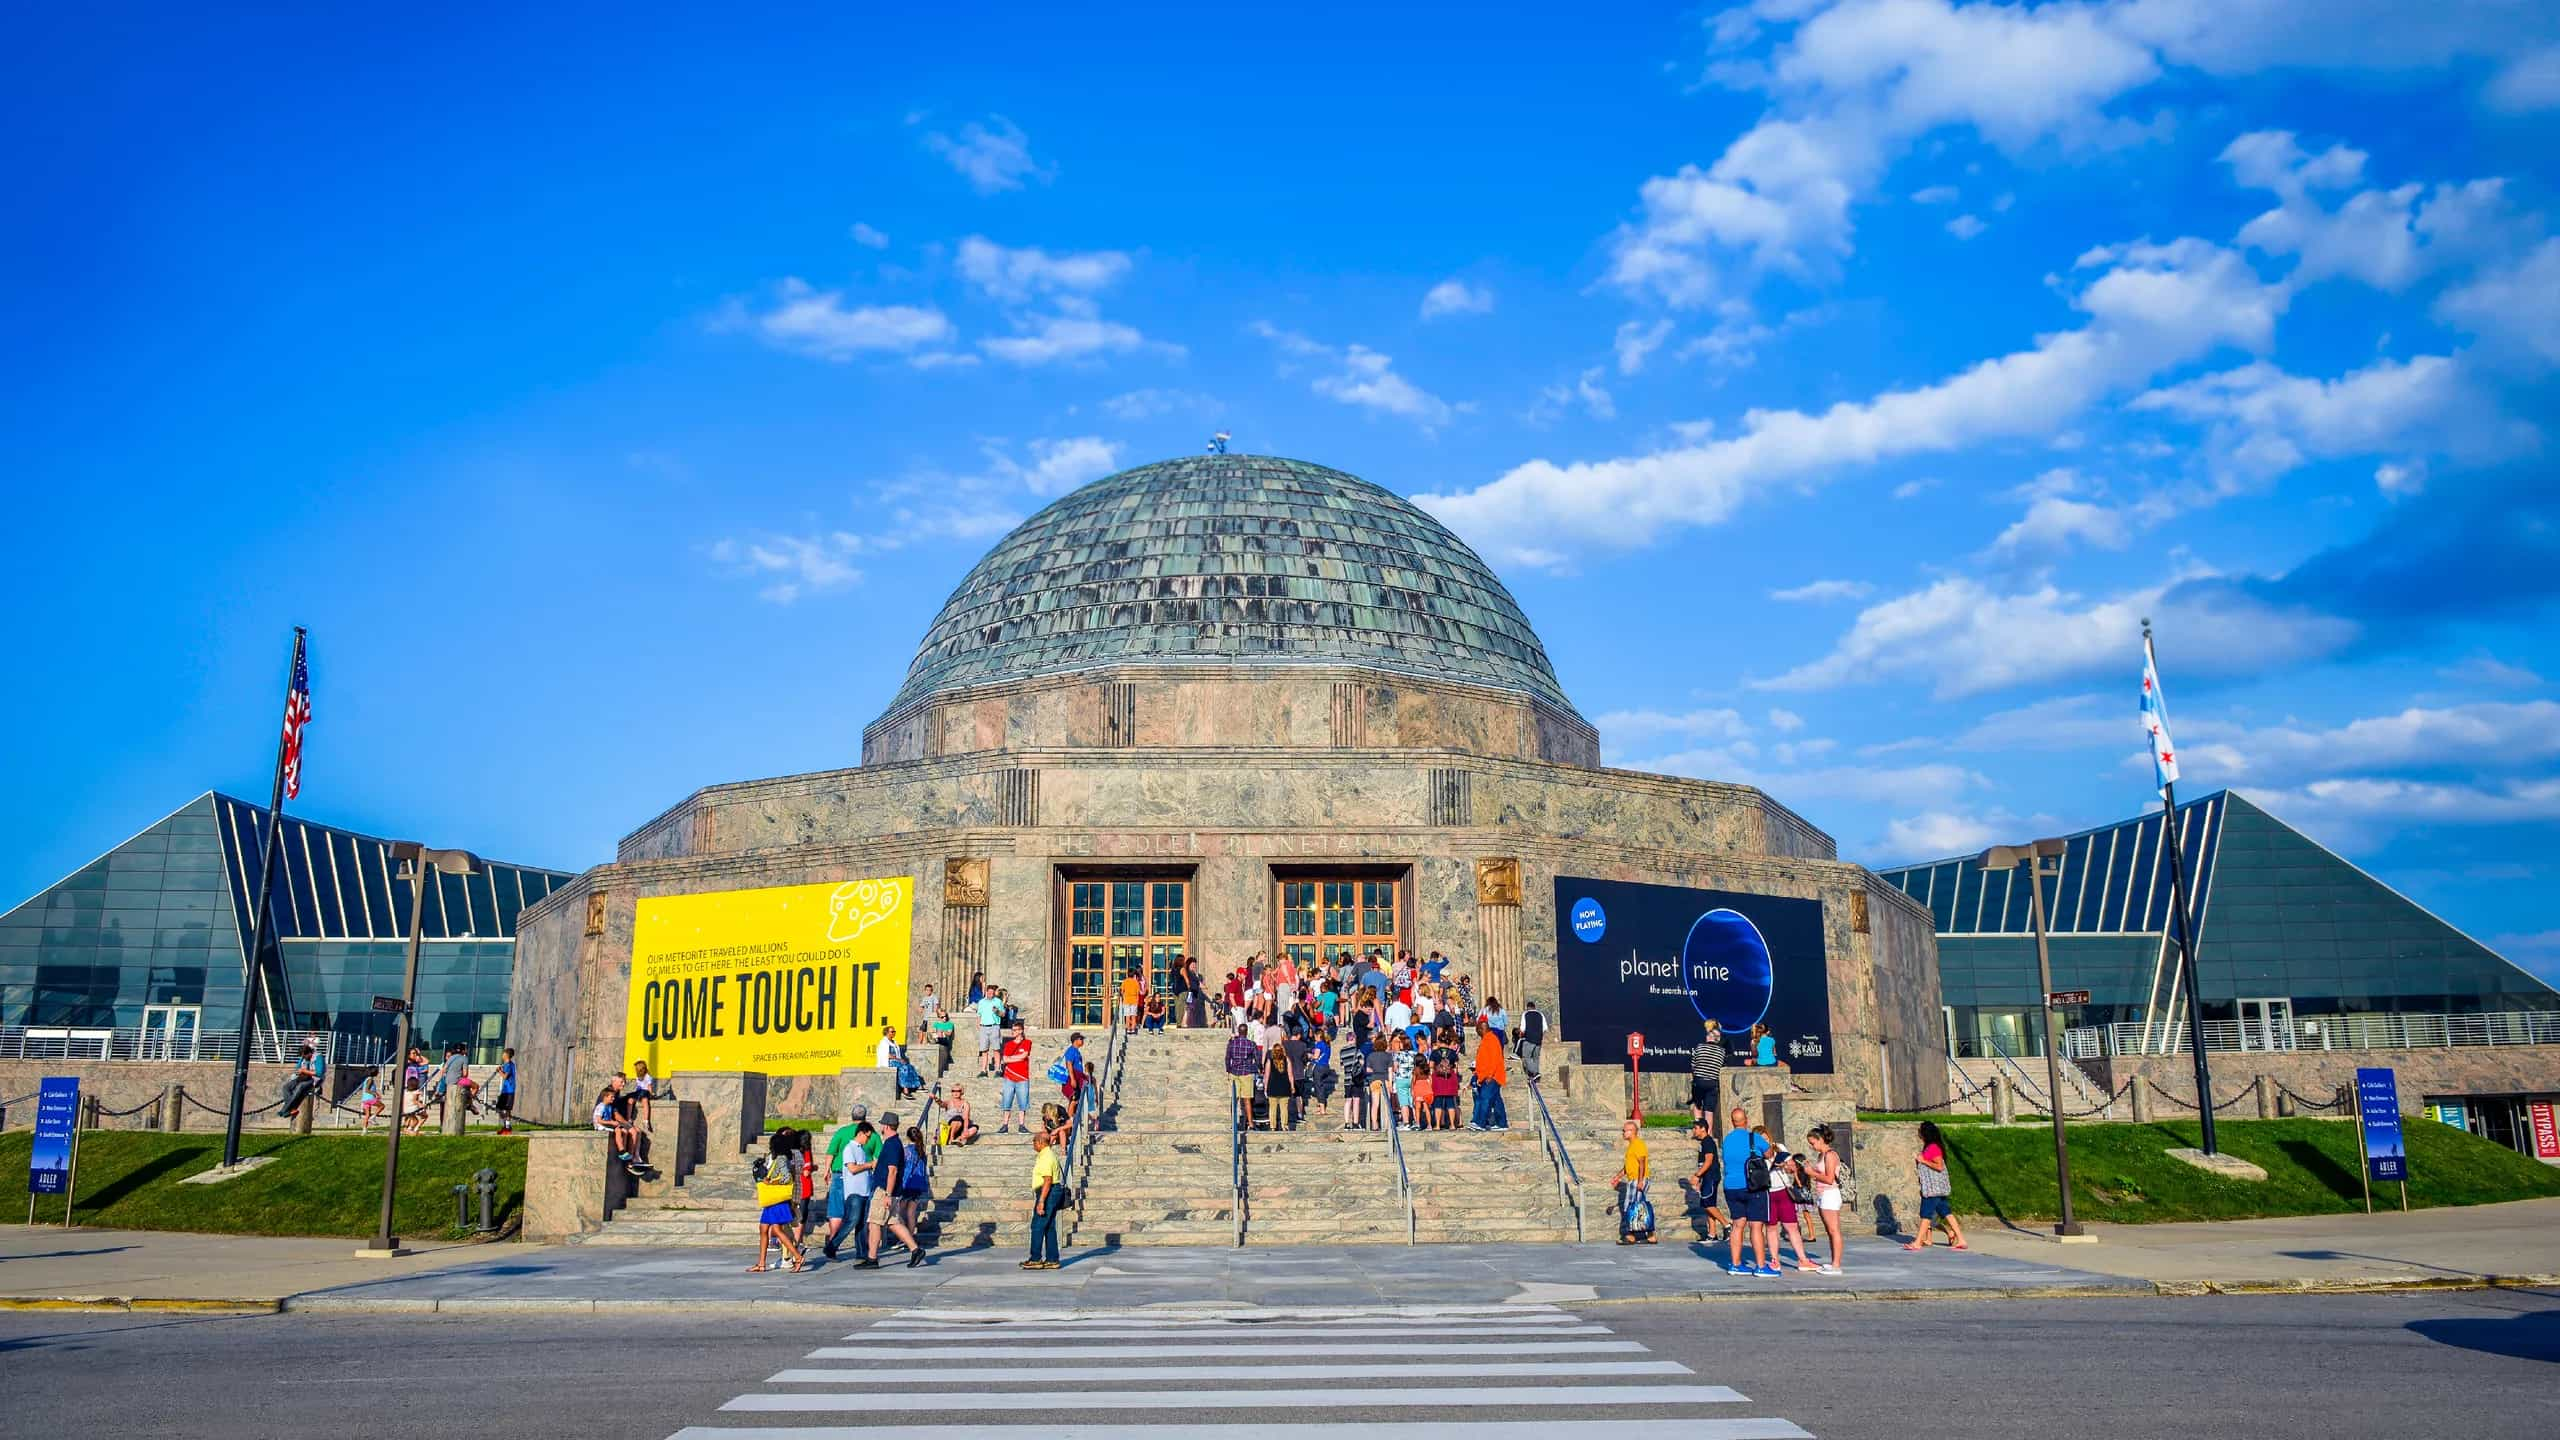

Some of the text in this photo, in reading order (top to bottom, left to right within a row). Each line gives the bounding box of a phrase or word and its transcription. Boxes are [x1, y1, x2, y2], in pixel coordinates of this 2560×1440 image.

[1578, 909, 1596, 920] NOW
[1575, 919, 1604, 931] PLAYING
[646, 966, 657, 977] OF
[658, 963, 681, 976] MILES
[682, 962, 693, 973] TO
[694, 961, 709, 973] GET
[734, 957, 750, 968] THE
[751, 955, 775, 968] LEAST
[776, 953, 795, 965] YOU
[796, 950, 827, 963] COULD
[827, 949, 842, 960] DO
[843, 948, 852, 959] IS
[647, 941, 789, 965] OUR METEORITE TRAVELED MILLIONS
[1620, 948, 1729, 983] planet nine
[1650, 983, 1698, 998] the search is on
[643, 962, 888, 1042] COME TOUCH IT.
[752, 1053, 771, 1064] SPACE
[779, 1050, 809, 1062] FREAKING
